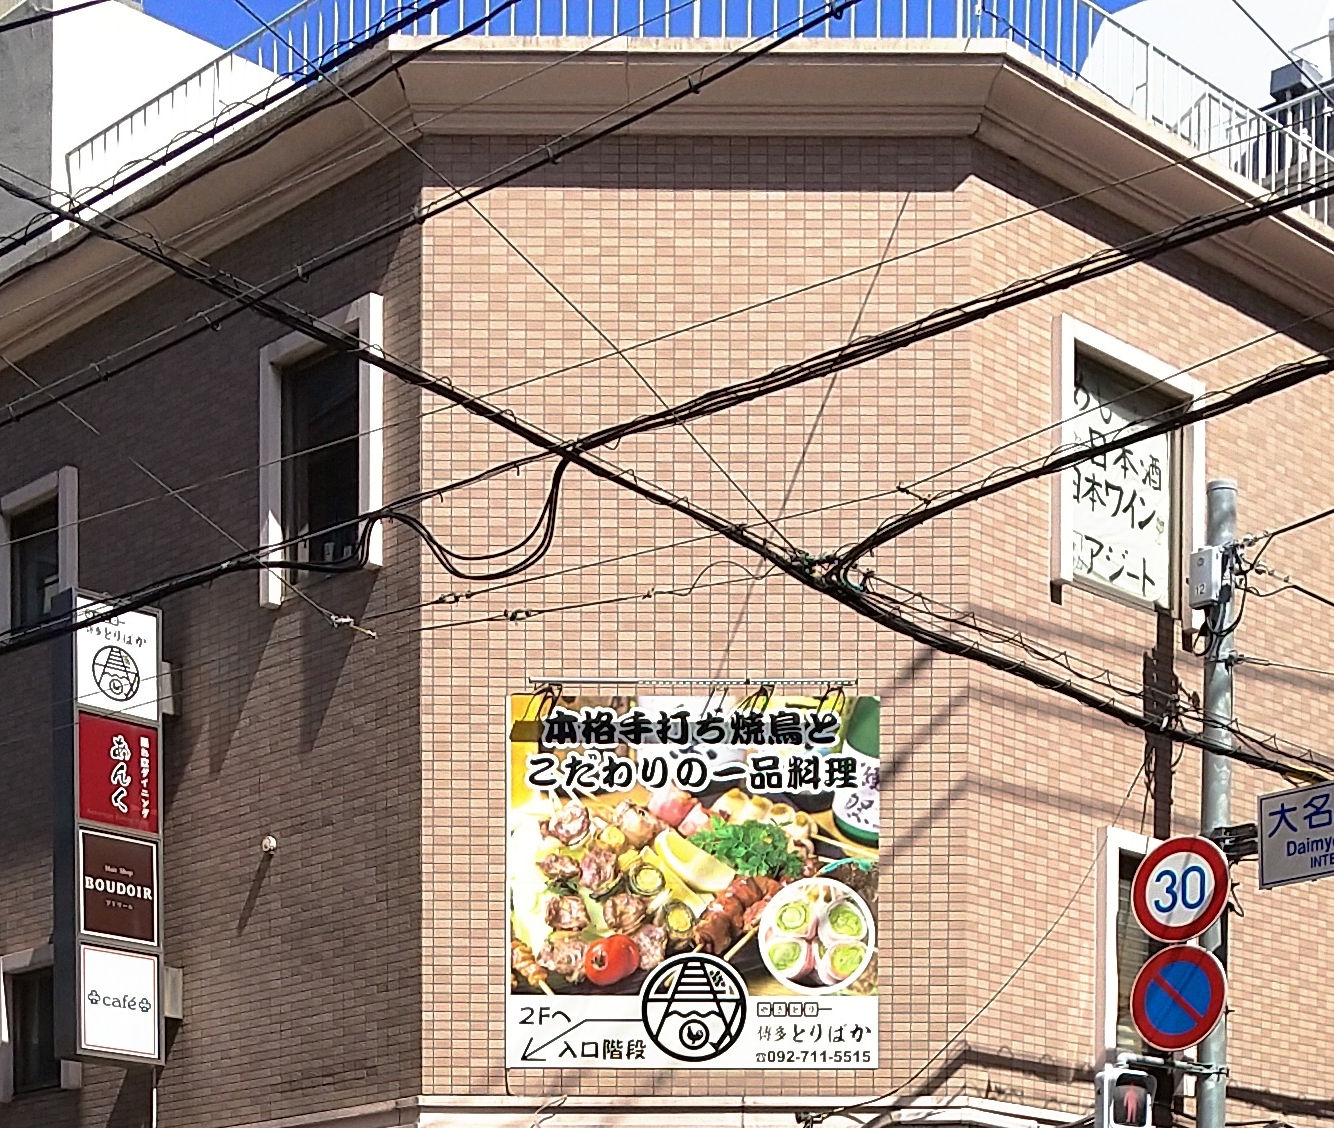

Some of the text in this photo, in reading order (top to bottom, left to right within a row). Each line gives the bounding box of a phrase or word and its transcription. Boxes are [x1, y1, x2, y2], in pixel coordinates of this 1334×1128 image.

[1084, 534, 1155, 597] アジート
[543, 710, 840, 745] 本格手打ち焼鳥と
[527, 755, 860, 790] こだわりの一品料理
[84, 876, 153, 900] BOUDOIR
[1153, 864, 1207, 914] 30
[102, 993, 137, 1012] café
[558, 1039, 647, 1060] 入口階段
[767, 1050, 871, 1063] 092-711-5515
